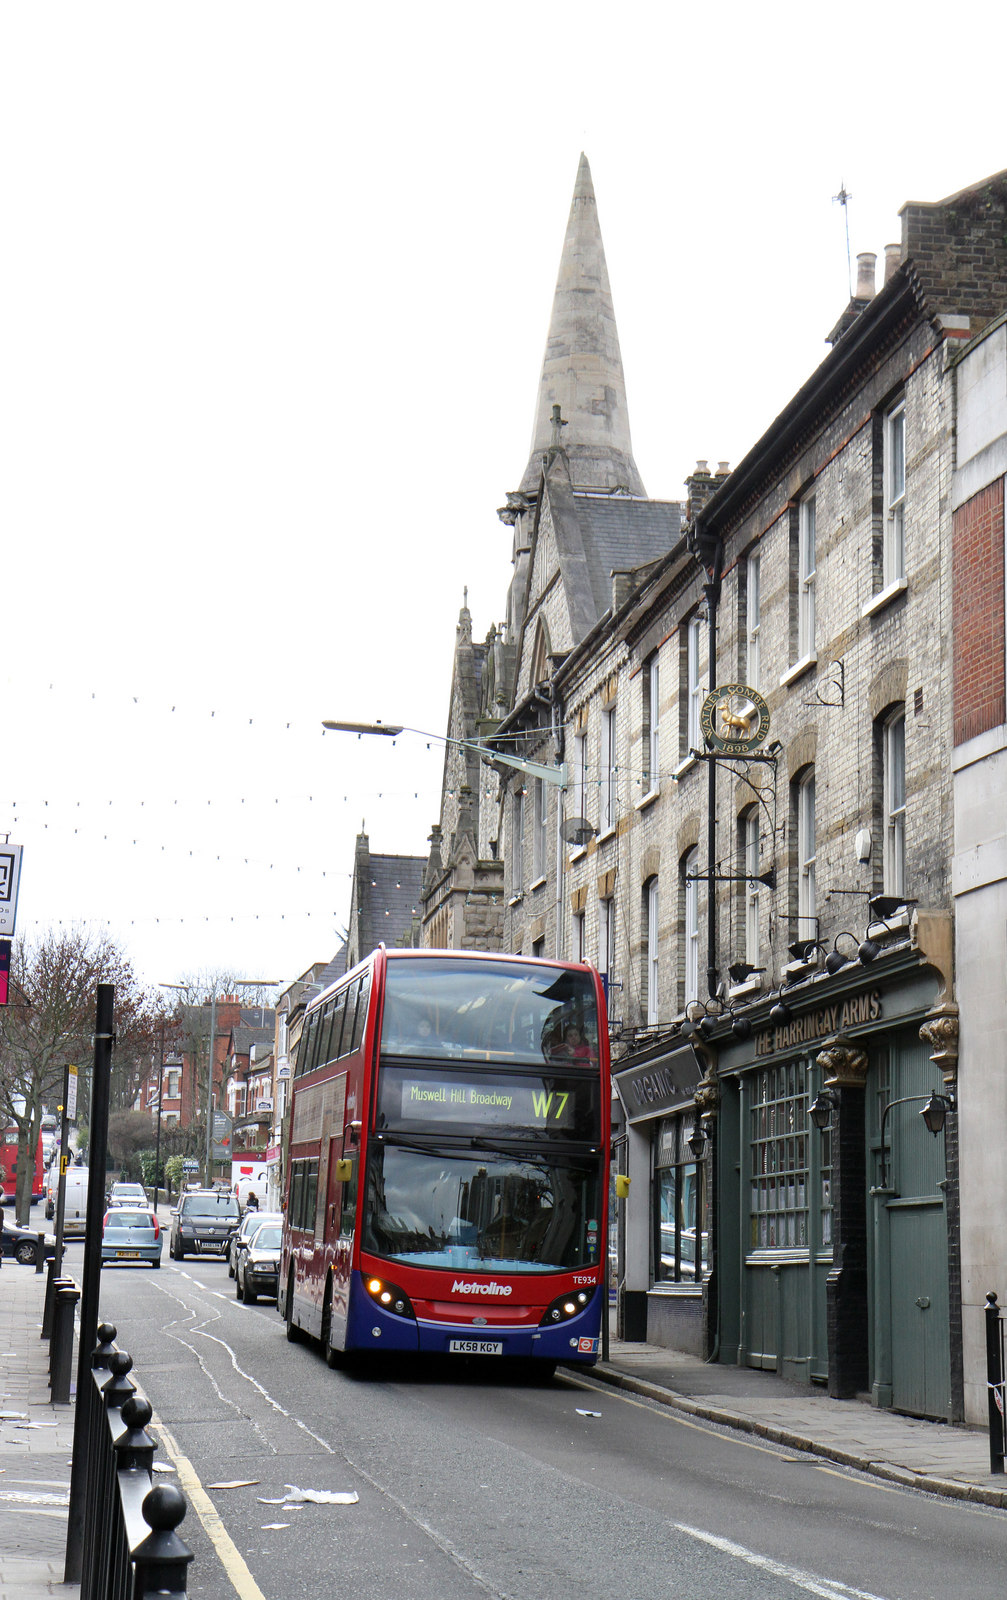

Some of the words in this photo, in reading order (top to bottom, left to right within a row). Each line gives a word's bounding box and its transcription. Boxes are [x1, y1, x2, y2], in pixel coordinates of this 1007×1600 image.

[702, 689, 721, 739] WATNEY
[728, 686, 766, 709] COMBE
[756, 715, 769, 740] REID
[722, 743, 749, 753] 1898
[754, 1029, 774, 1056] THE
[775, 1005, 838, 1050] HARRINGAY
[842, 991, 880, 1027] ARMS
[411, 1086, 446, 1102] Muswell
[450, 1088, 466, 1103] Hill
[470, 1089, 513, 1110] Broadway
[632, 1068, 676, 1106] ORGANIC
[531, 1090, 569, 1119] W7
[451, 1280, 512, 1296] Metroline
[573, 1276, 596, 1284] TE934
[453, 1341, 478, 1352] LK58
[479, 1342, 499, 1353] KGY
